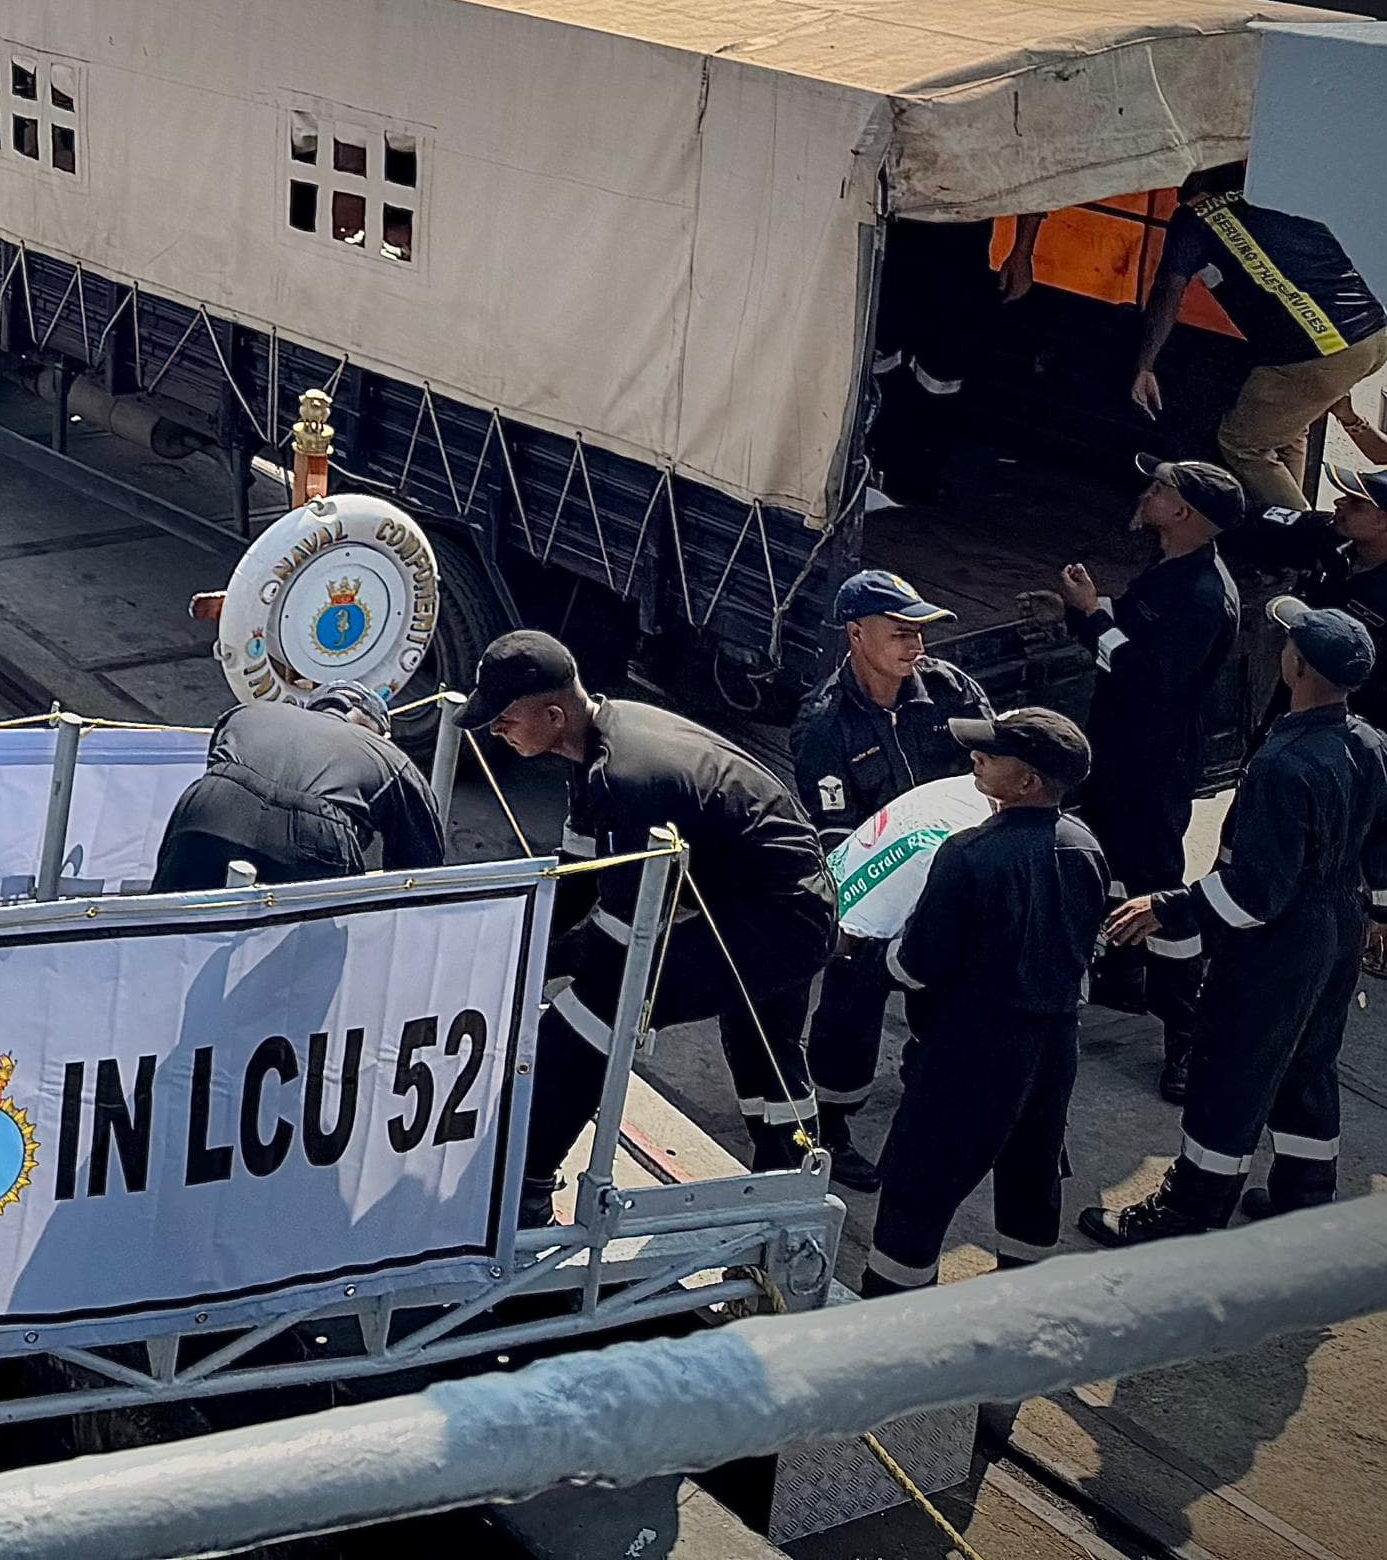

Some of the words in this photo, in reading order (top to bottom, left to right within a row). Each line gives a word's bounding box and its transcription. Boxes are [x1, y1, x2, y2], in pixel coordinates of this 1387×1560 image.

[1213, 213, 1258, 262] SERVING
[1273, 282, 1327, 334] SRVICES
[272, 520, 348, 582] NAVAL
[375, 517, 436, 651] COMPONENT
[842, 878, 868, 906] ong
[867, 846, 905, 880] Grain
[54, 1055, 157, 1201] IN
[184, 1028, 365, 1188] LCU
[386, 1008, 487, 1154] 52
